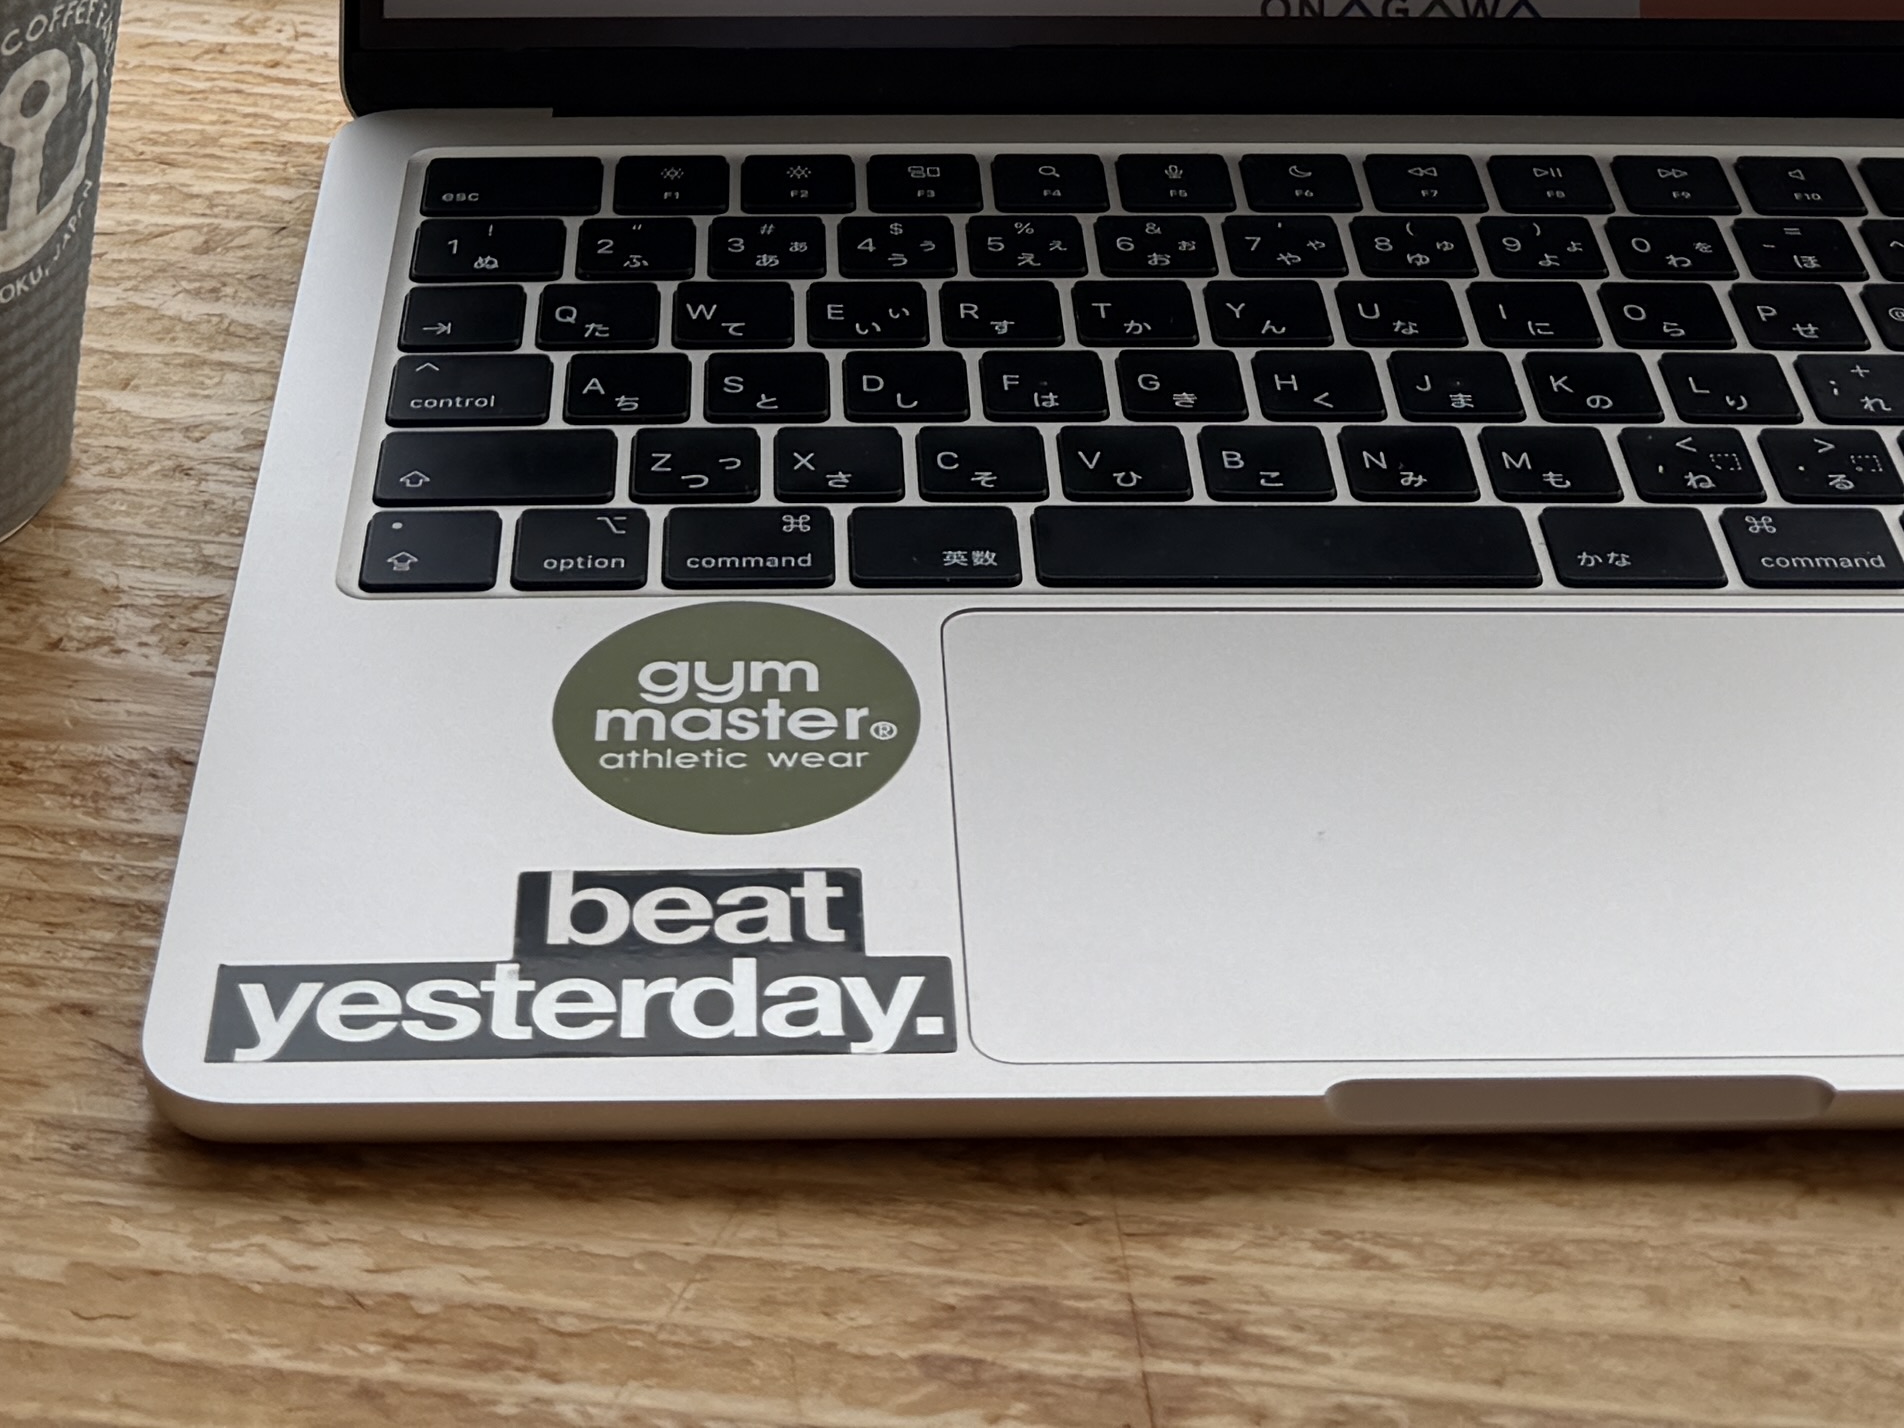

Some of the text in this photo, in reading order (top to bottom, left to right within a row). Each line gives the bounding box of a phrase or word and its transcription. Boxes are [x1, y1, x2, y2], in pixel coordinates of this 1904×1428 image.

[442, 193, 479, 201] esc
[448, 240, 458, 254] 1
[597, 239, 613, 253] 2
[728, 238, 744, 252] 3
[857, 238, 875, 252] 4
[988, 237, 1004, 251] 5
[1117, 237, 1134, 251] 6
[1245, 237, 1261, 250] 7
[1375, 237, 1393, 251] 8
[1502, 237, 1521, 252] 9
[555, 306, 577, 323] Q
[687, 304, 717, 320] W
[827, 304, 844, 320] E
[960, 303, 978, 319] R
[1092, 303, 1111, 318] T
[1226, 303, 1245, 318] Y
[1358, 303, 1380, 319] U
[1624, 305, 1646, 320] O
[1757, 306, 1776, 321] P
[583, 378, 605, 394] A
[724, 376, 743, 393] S
[863, 375, 884, 391] D
[1003, 375, 1019, 390] F
[1138, 374, 1160, 390] G
[1275, 374, 1298, 390] H
[1416, 375, 1431, 391] J
[1550, 376, 1573, 392] K
[1689, 377, 1710, 393] L
[410, 396, 494, 408] control
[651, 454, 671, 471] Z
[794, 453, 814, 470] X
[937, 452, 959, 469] C
[1078, 451, 1100, 469] V
[1222, 451, 1244, 468] B
[1363, 451, 1387, 469] N
[1502, 452, 1531, 469] M
[544, 555, 624, 571] option
[687, 553, 811, 568] command
[943, 551, 997, 566] 英数
[1578, 552, 1631, 566] かな
[1761, 555, 1885, 568] command
[638, 658, 819, 705] gym
[599, 747, 871, 771] athletic wear
[545, 870, 846, 944] beat
[233, 957, 944, 1061] yesterday.
